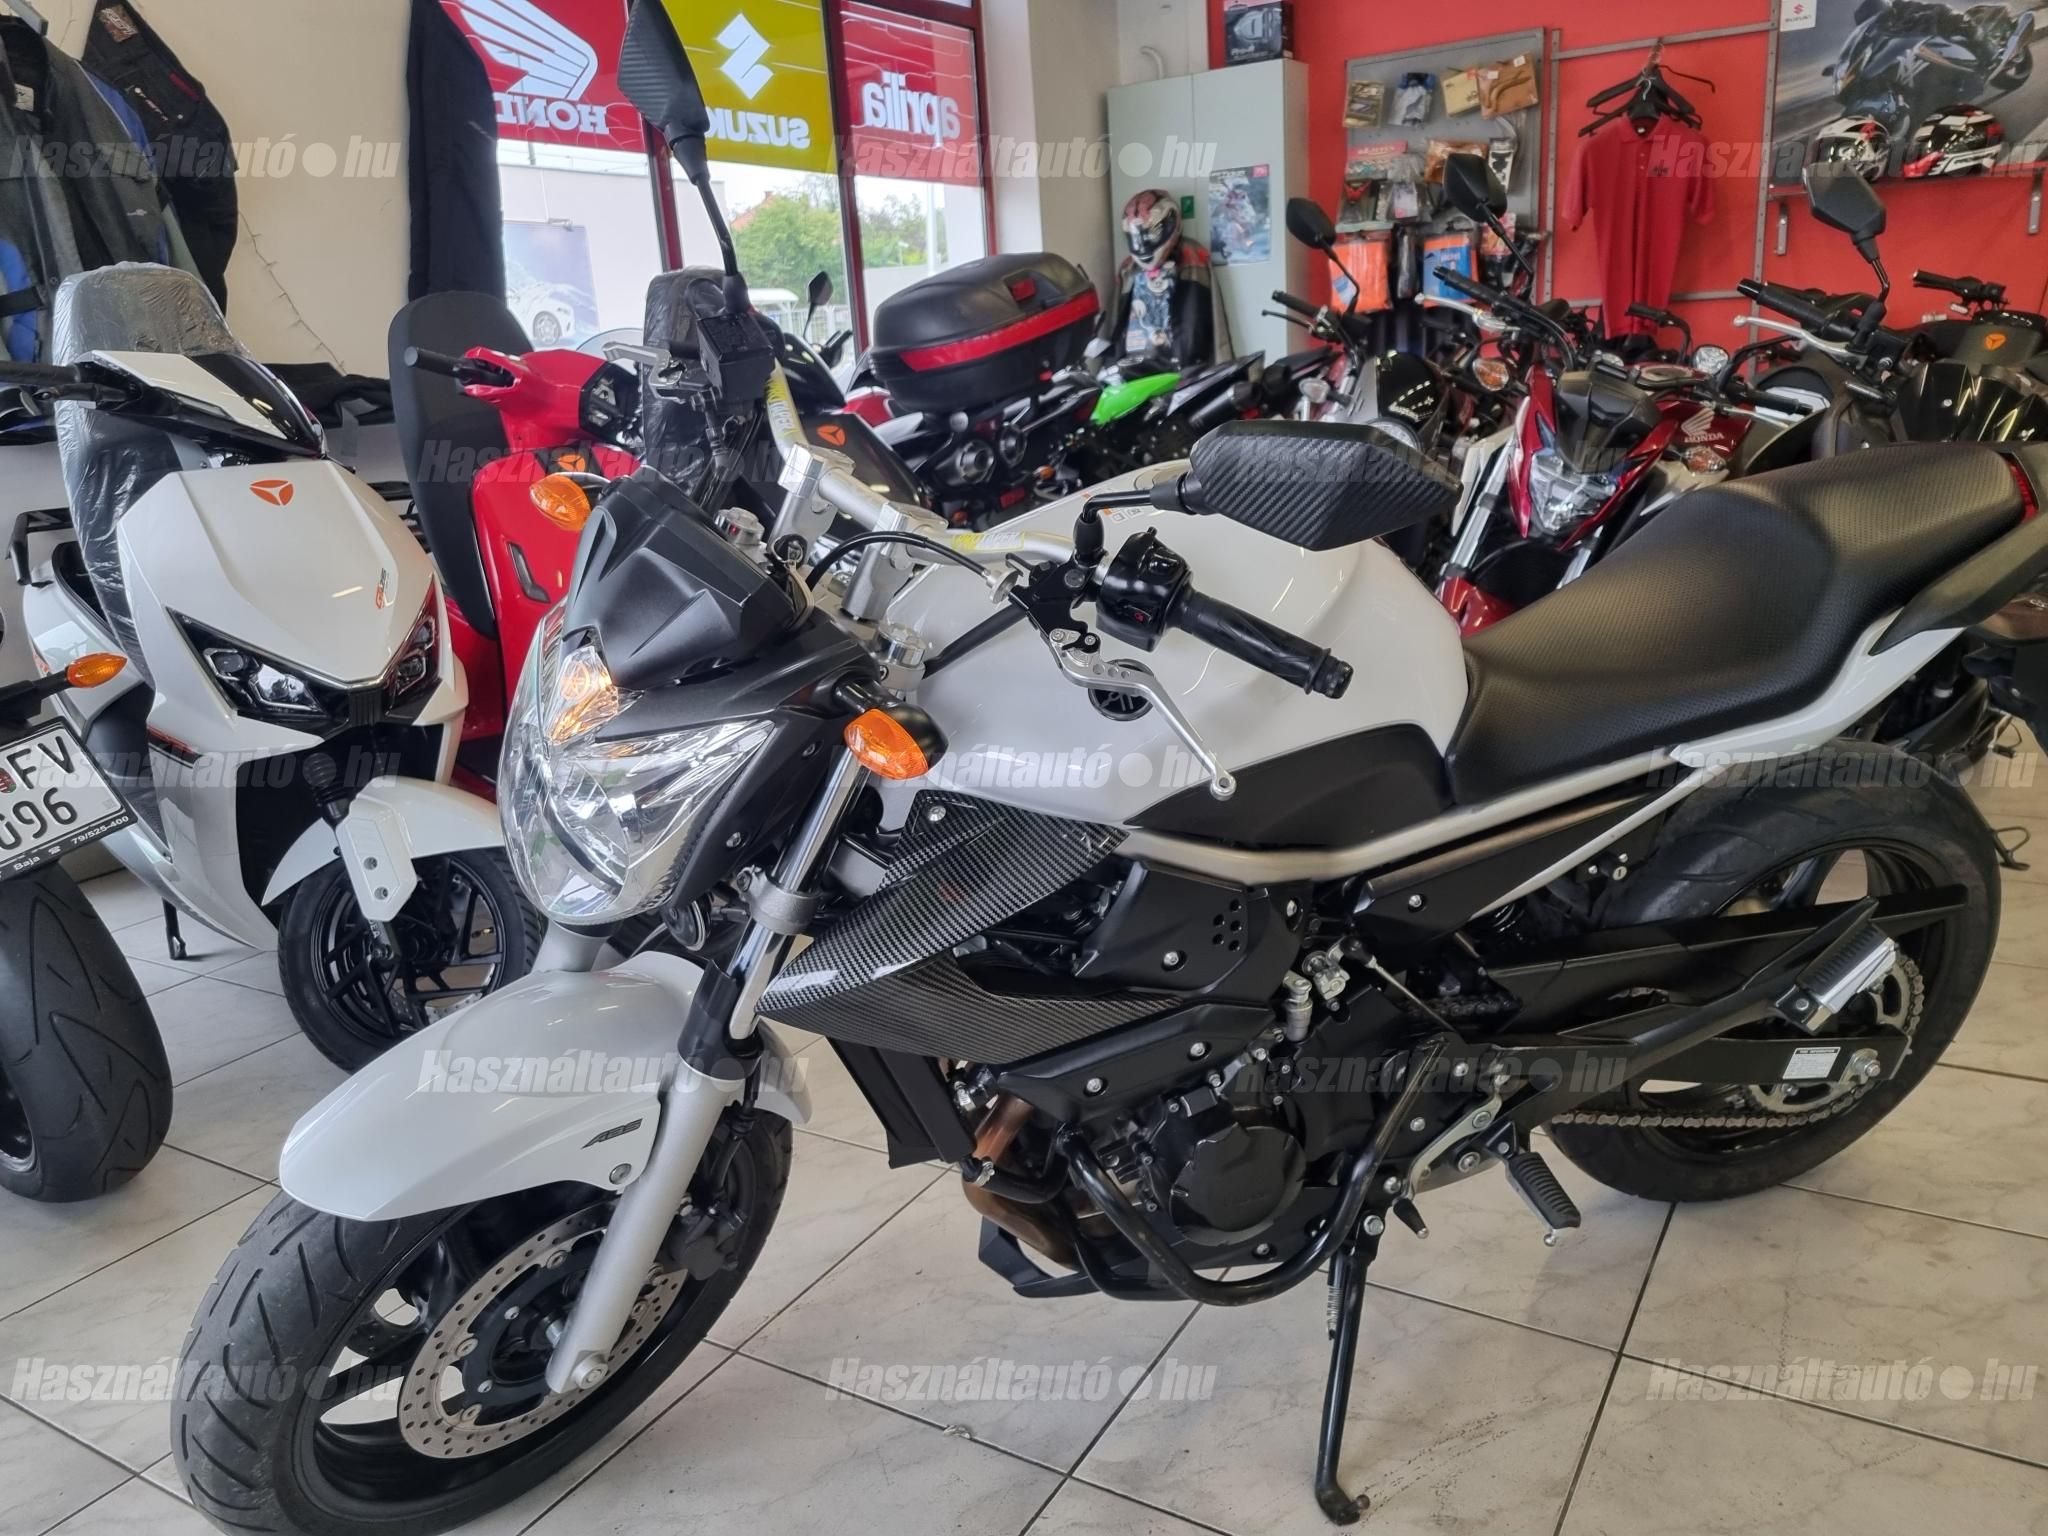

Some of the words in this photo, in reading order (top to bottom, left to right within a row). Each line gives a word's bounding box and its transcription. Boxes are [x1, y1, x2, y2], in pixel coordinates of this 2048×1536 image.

[1684, 432, 1725, 443] HONDA
[6, 735, 76, 790] FV
[14, 855, 41, 871] Baja
[71, 815, 130, 846] 79/525-400
[580, 1117, 643, 1149] ABS
